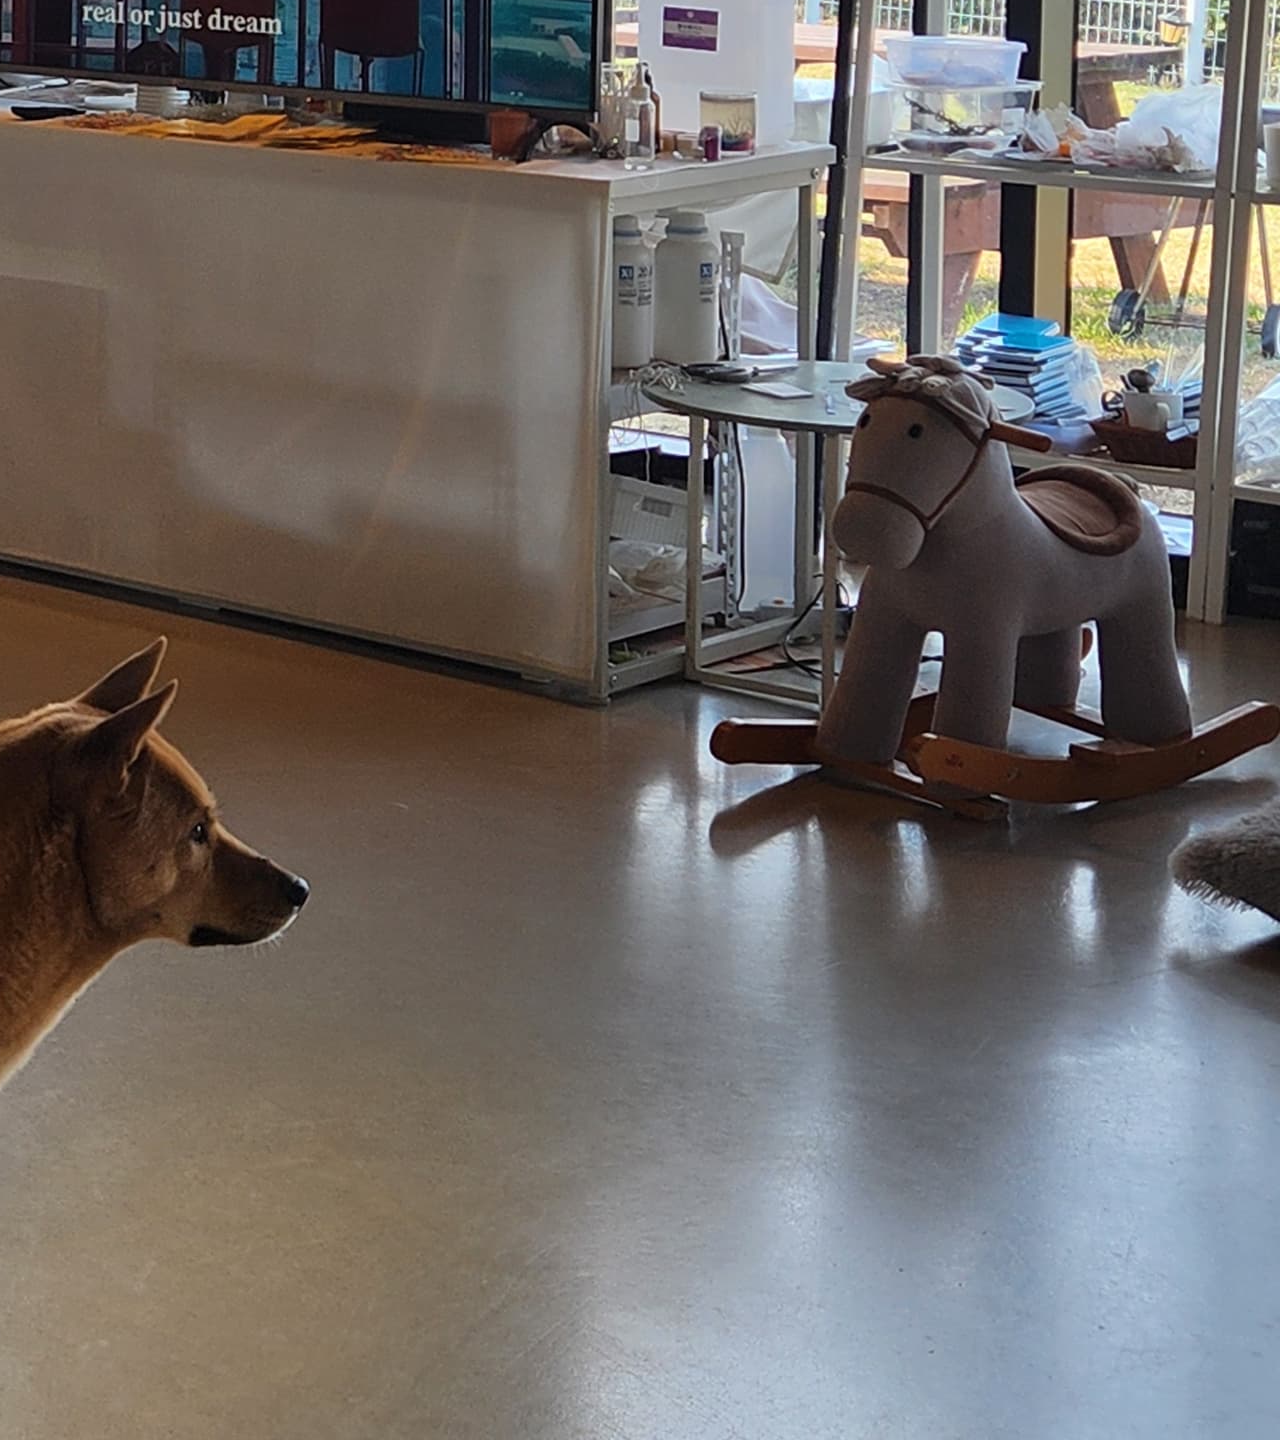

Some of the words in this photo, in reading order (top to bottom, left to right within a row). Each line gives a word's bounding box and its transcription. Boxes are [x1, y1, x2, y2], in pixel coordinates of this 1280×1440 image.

[82, 2, 125, 25] real
[130, 8, 154, 26] or
[155, 4, 202, 34] just
[207, 8, 283, 35] dream
